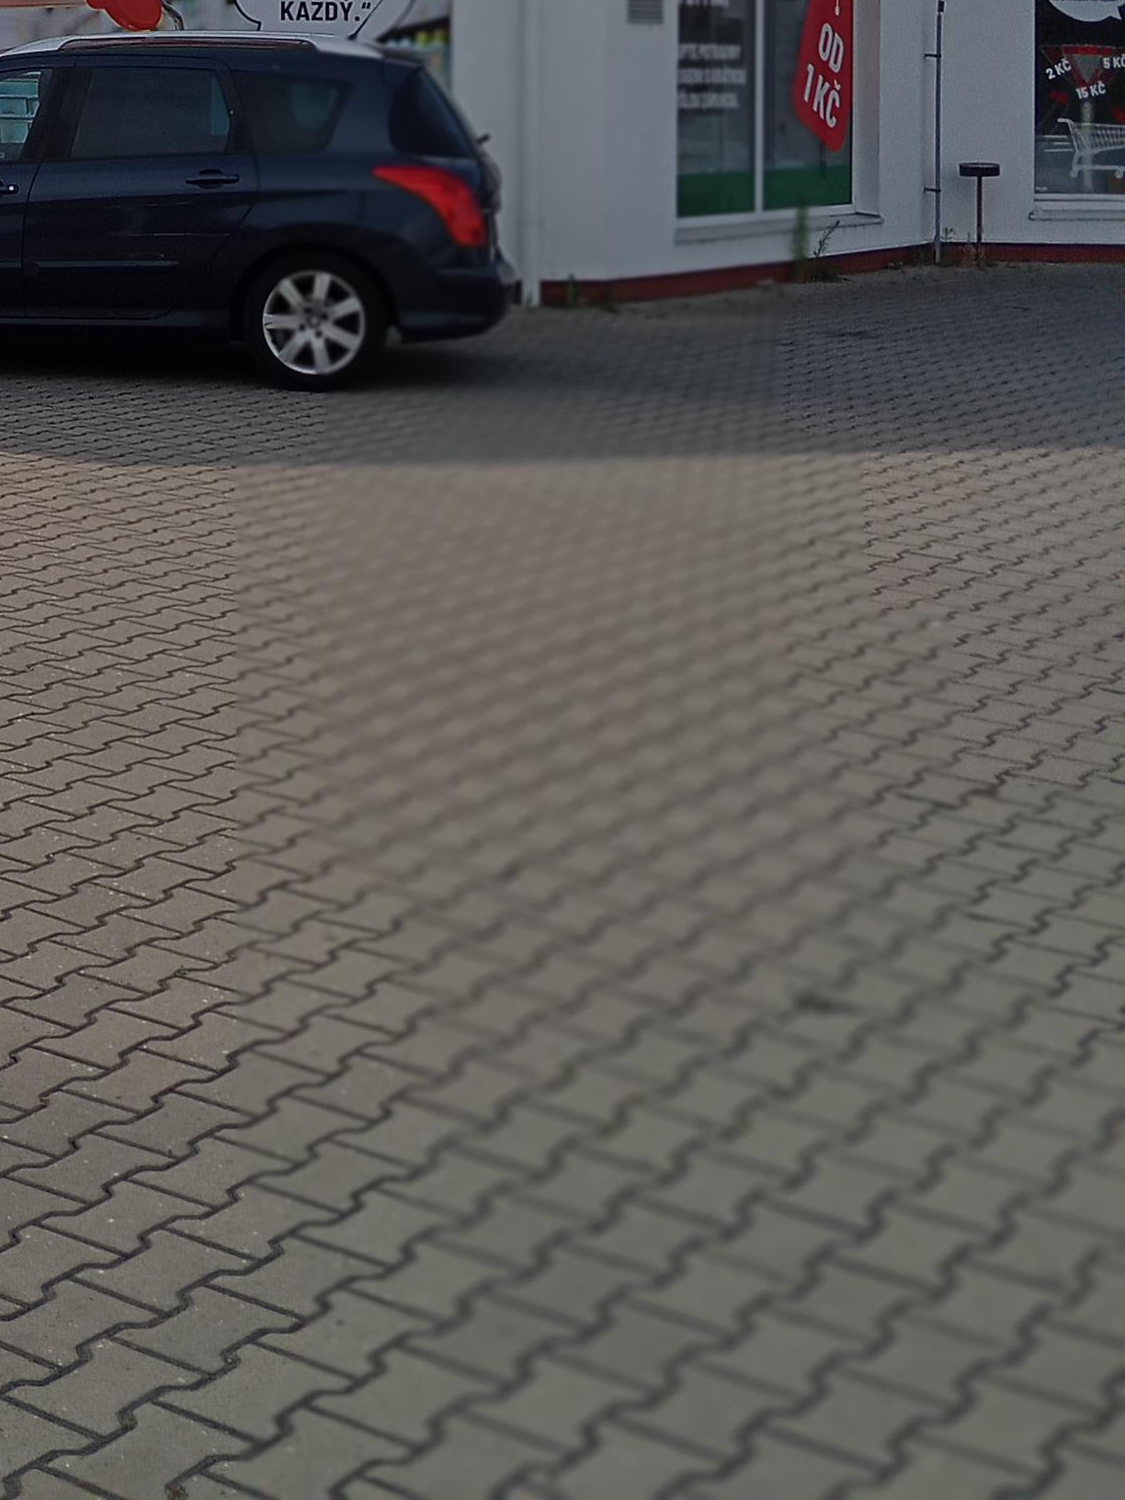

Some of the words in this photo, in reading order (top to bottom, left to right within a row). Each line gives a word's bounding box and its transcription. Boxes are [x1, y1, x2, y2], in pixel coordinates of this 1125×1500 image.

[818, 23, 844, 73] OD
[1045, 68, 1055, 80] 2
[1054, 58, 1072, 76] KČ
[1103, 57, 1111, 69] 5
[804, 64, 814, 103] 1
[813, 74, 841, 128] KČ
[1076, 87, 1089, 99] 15
[1089, 81, 1106, 96] KČ
